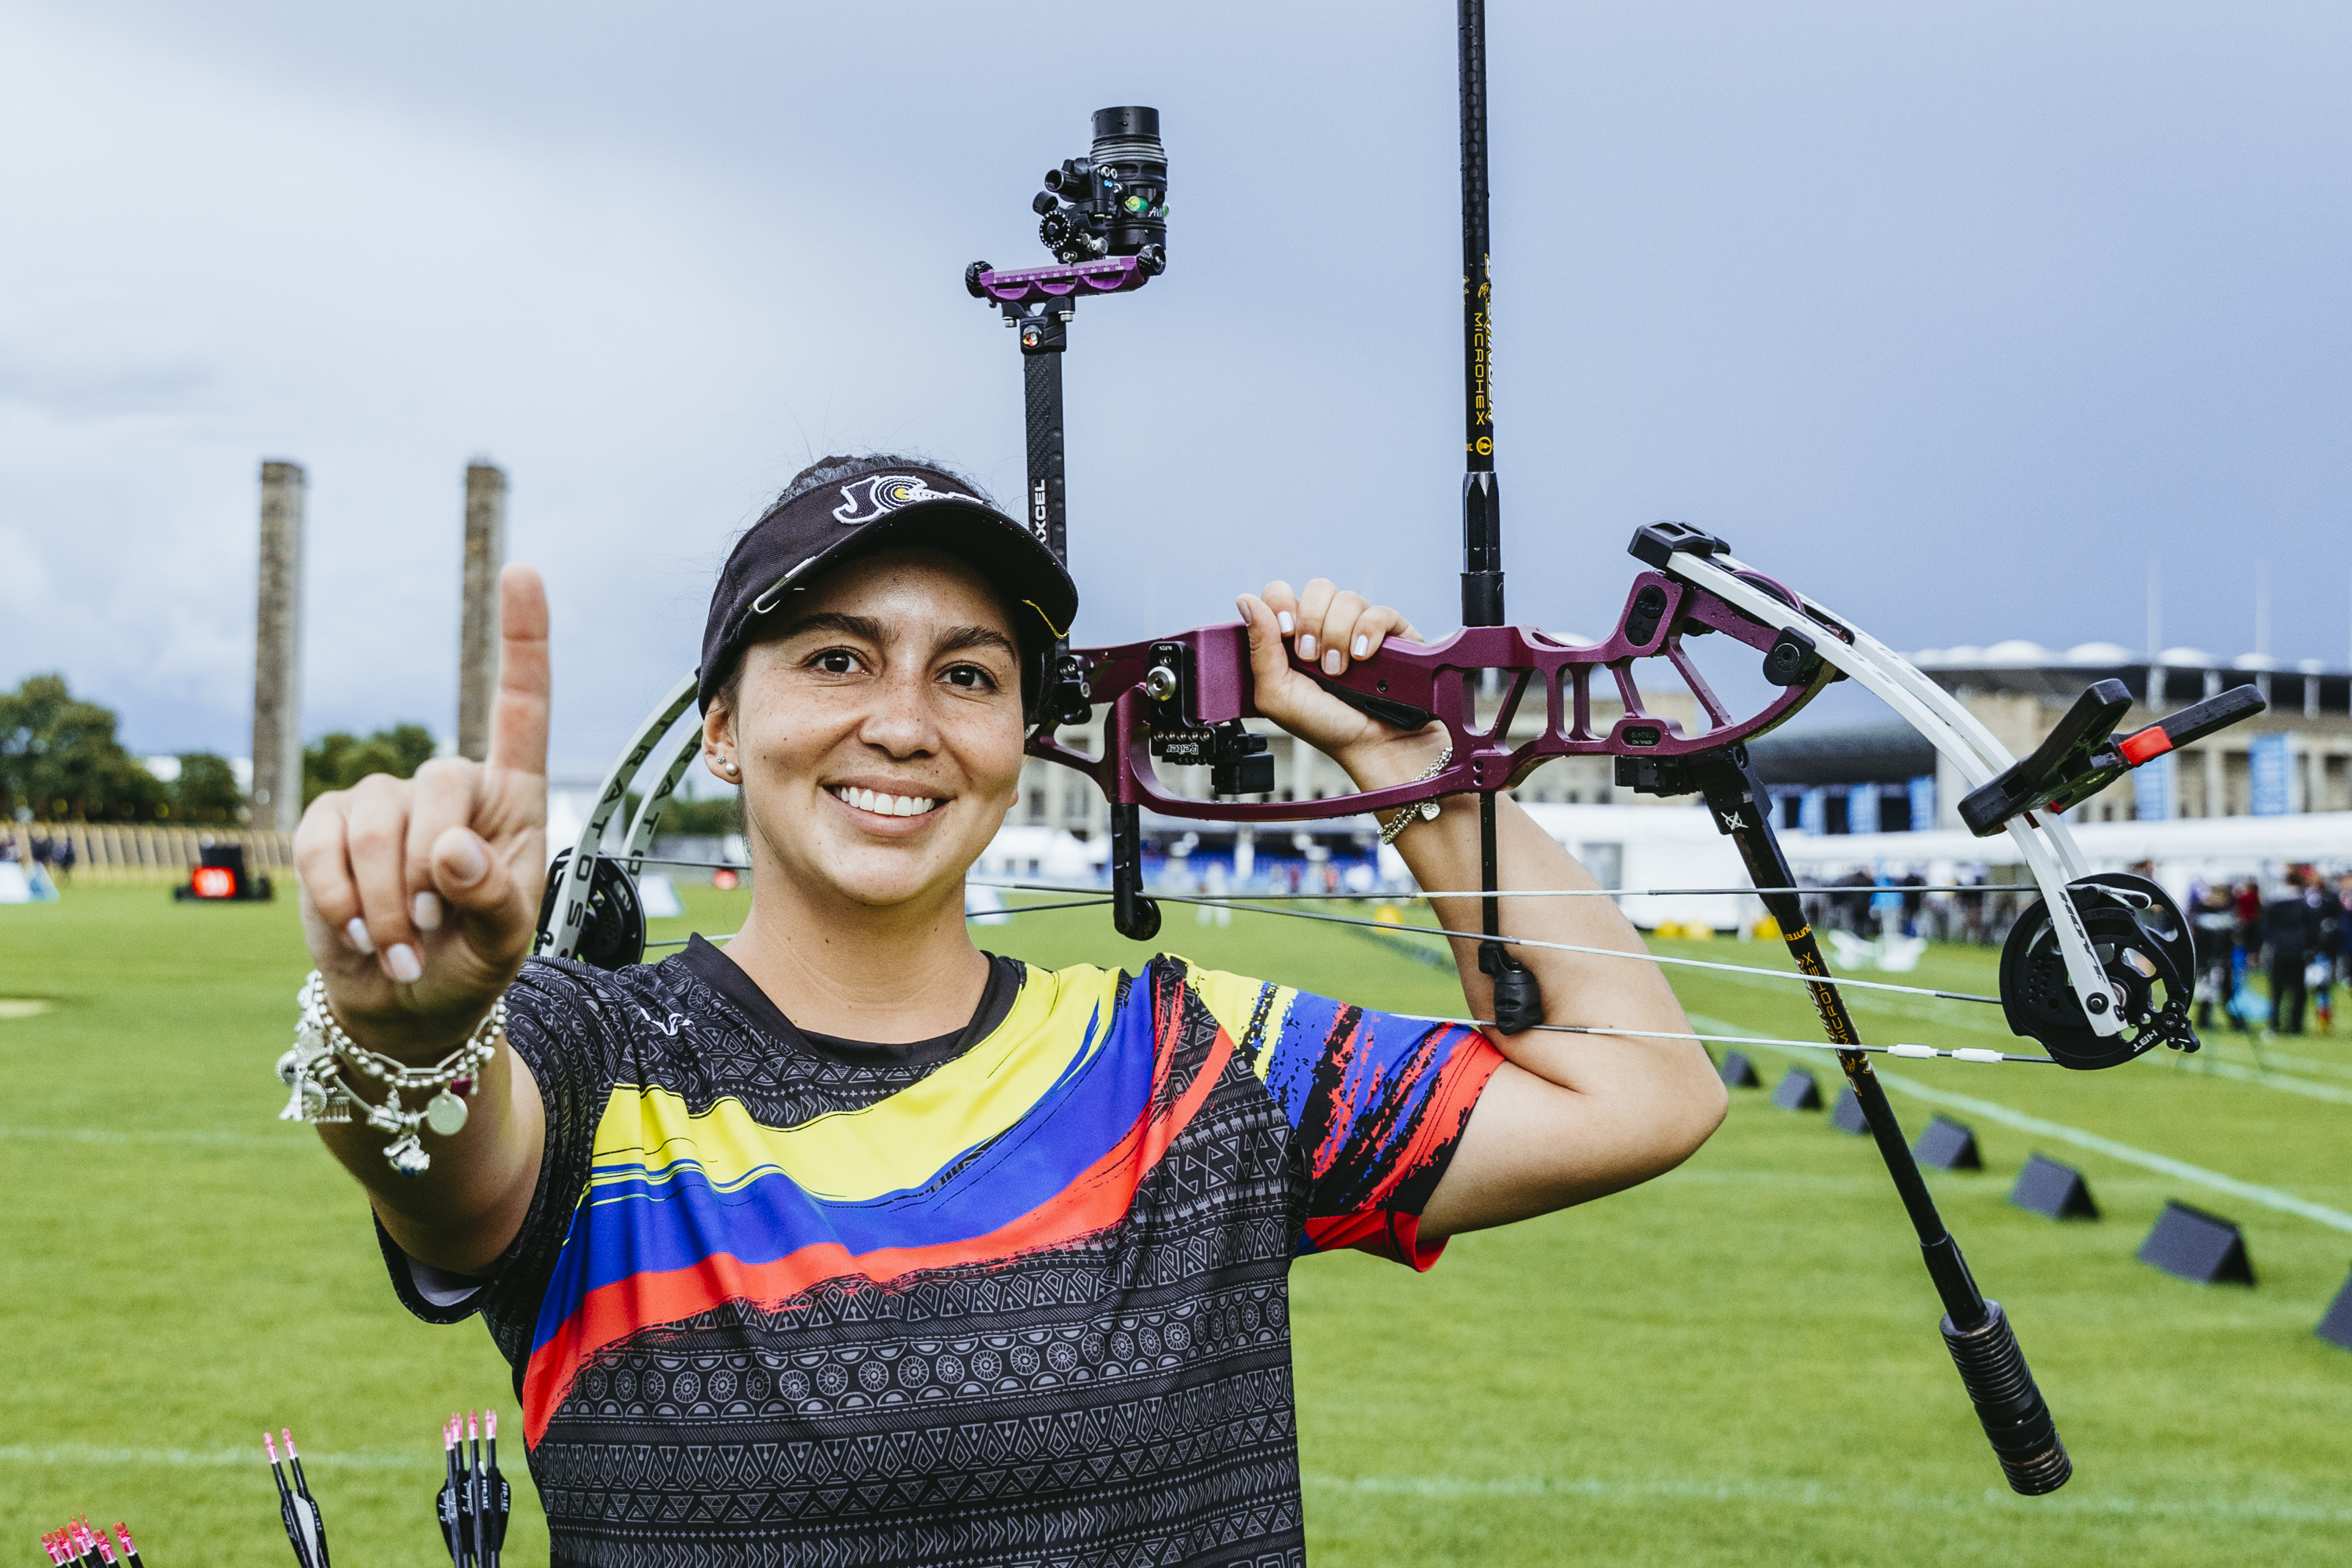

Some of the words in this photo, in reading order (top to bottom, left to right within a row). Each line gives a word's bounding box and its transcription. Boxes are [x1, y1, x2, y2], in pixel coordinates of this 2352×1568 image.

[1475, 312, 1485, 425] MICROHEX
[1167, 742, 1199, 755] Beiter
[2132, 1029, 2159, 1052] HBT
